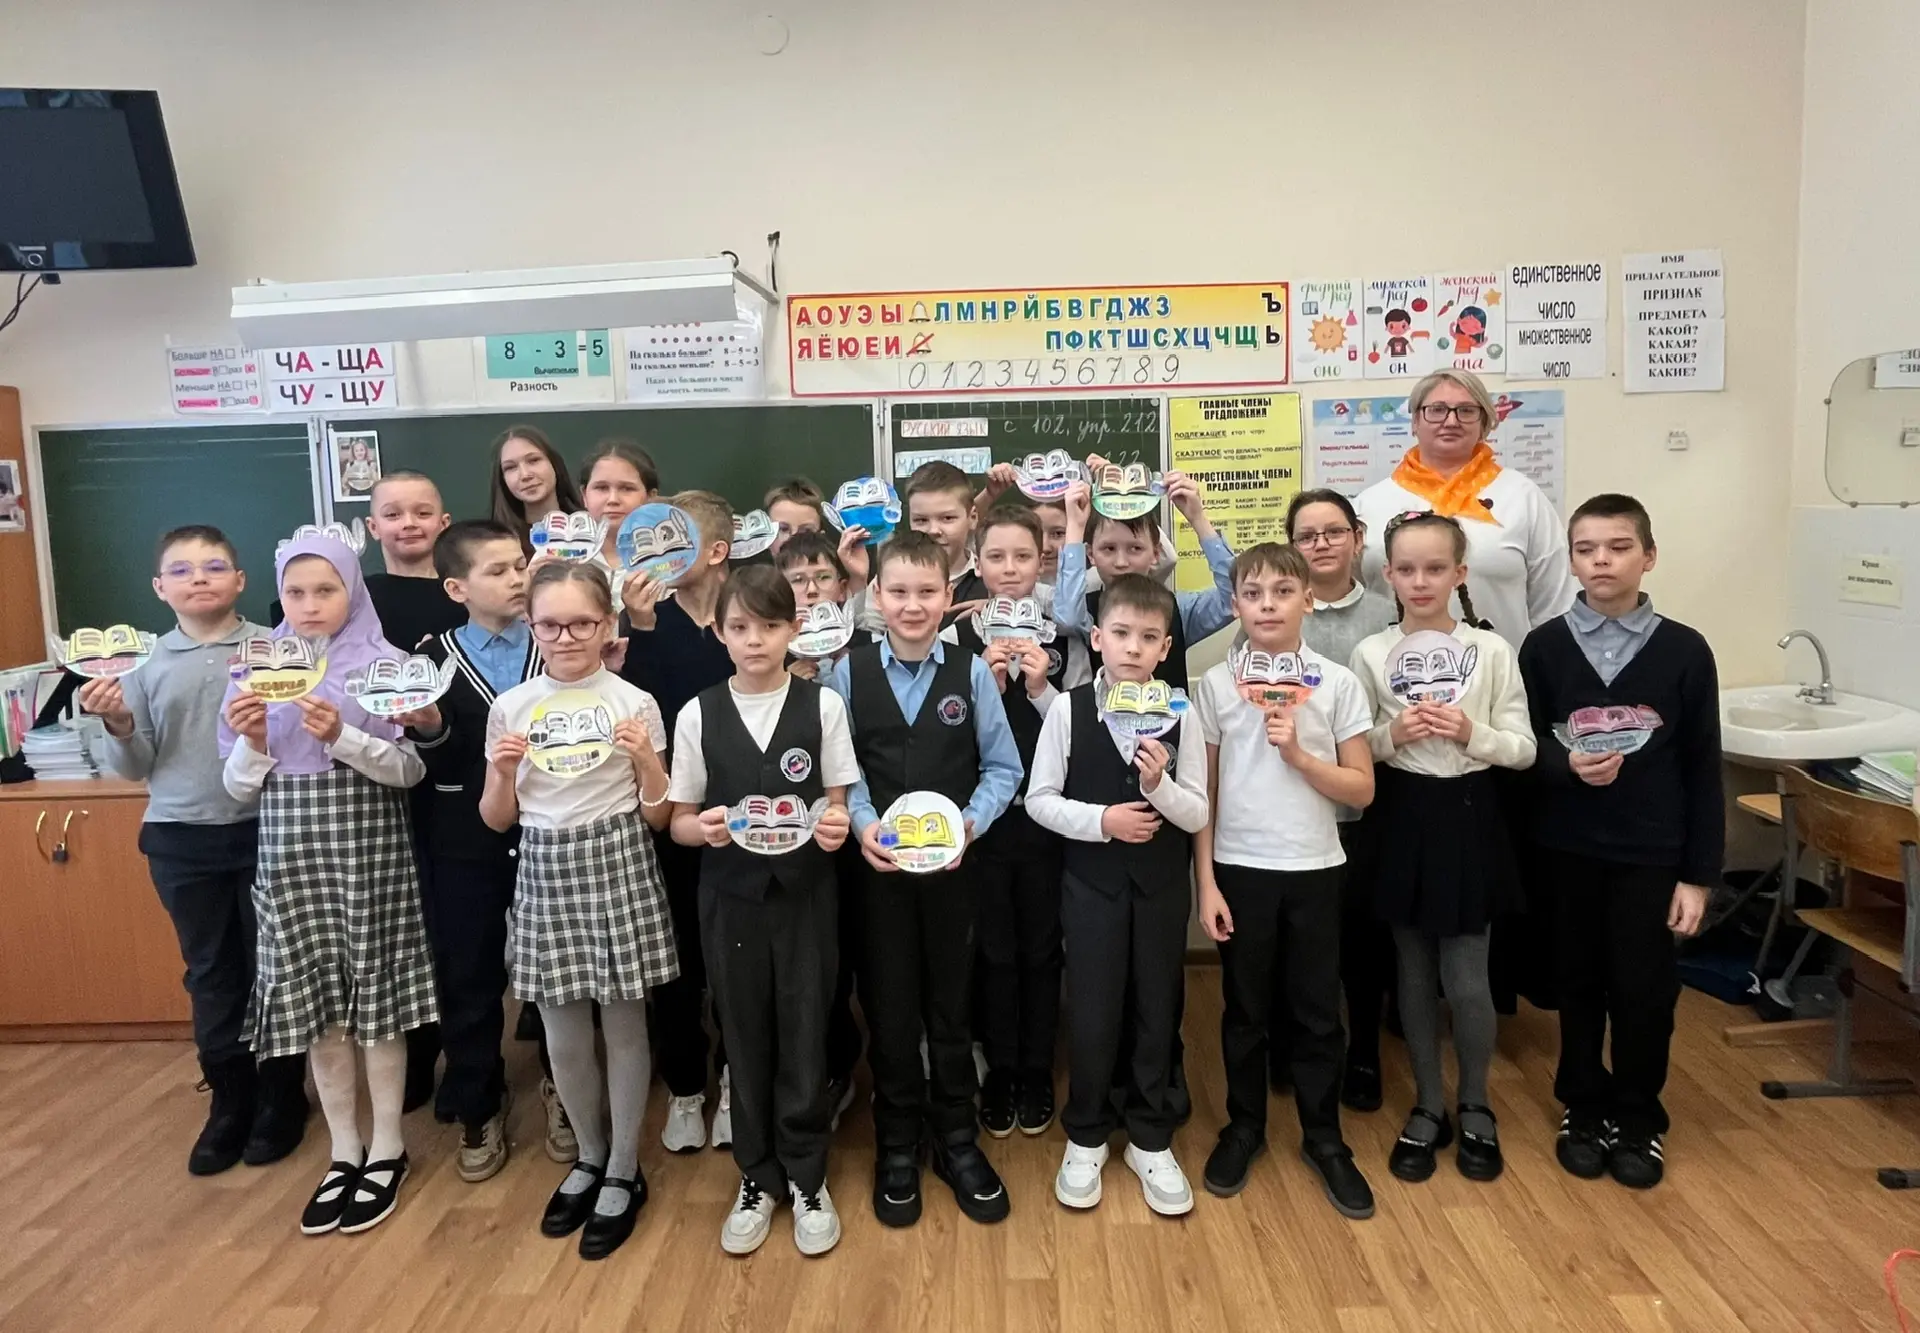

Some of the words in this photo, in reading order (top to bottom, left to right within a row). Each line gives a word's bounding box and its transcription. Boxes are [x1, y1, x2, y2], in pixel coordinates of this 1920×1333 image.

[1661, 255, 1685, 263] ИМЯ
[1440, 272, 1497, 286] женский
[1512, 263, 1601, 288] единственное
[1625, 269, 1721, 281] ПРИЛАГАТЕЛЬНОЕ
[1368, 278, 1428, 299] мужской
[1457, 285, 1480, 304] род
[1643, 287, 1703, 300] ПРИЗНАК
[1261, 292, 1282, 313] Ъ
[1386, 291, 1409, 308] род
[1538, 301, 1576, 320] число
[1638, 309, 1707, 321] ПРЕДМЕТА
[1265, 325, 1281, 344] Ь
[1518, 327, 1592, 346] множественное
[1648, 325, 1699, 336] КАКОЙ?
[505, 341, 516, 360] 8
[554, 340, 566, 358] 3
[592, 339, 604, 358] 5
[1648, 339, 1698, 350] КАКАЯ?
[275, 351, 314, 373] ЧА
[337, 348, 384, 373] ЩА
[1453, 358, 1485, 370] она
[1648, 353, 1698, 365] КАКОЕ?
[1314, 364, 1342, 377] оно
[1389, 362, 1409, 374] он
[1543, 361, 1571, 378] число
[1648, 367, 1698, 378] КАКИЕ?
[510, 381, 558, 392] Разность
[279, 383, 315, 405] ЧУ
[342, 381, 385, 406] ЩУ
[1199, 399, 1239, 409] ГЛАВНЫЕ
[1241, 398, 1272, 407] ЧЛЕНЫ
[1204, 408, 1267, 420] ПРЕДЛОЖЕНИЯ
[957, 421, 987, 436] ЯЗЫК
[1174, 430, 1227, 440] ПОДЛЕЖАЩЕЕ
[1175, 449, 1221, 458] СКАЗУЕМОЕ
[1186, 469, 1260, 483] ТОРОСТЕПЕННЫЕ
[1262, 468, 1292, 479] ЧЛЕНЫ
[1206, 481, 1270, 492] ПРЕДЛОЖЕНИЯ
